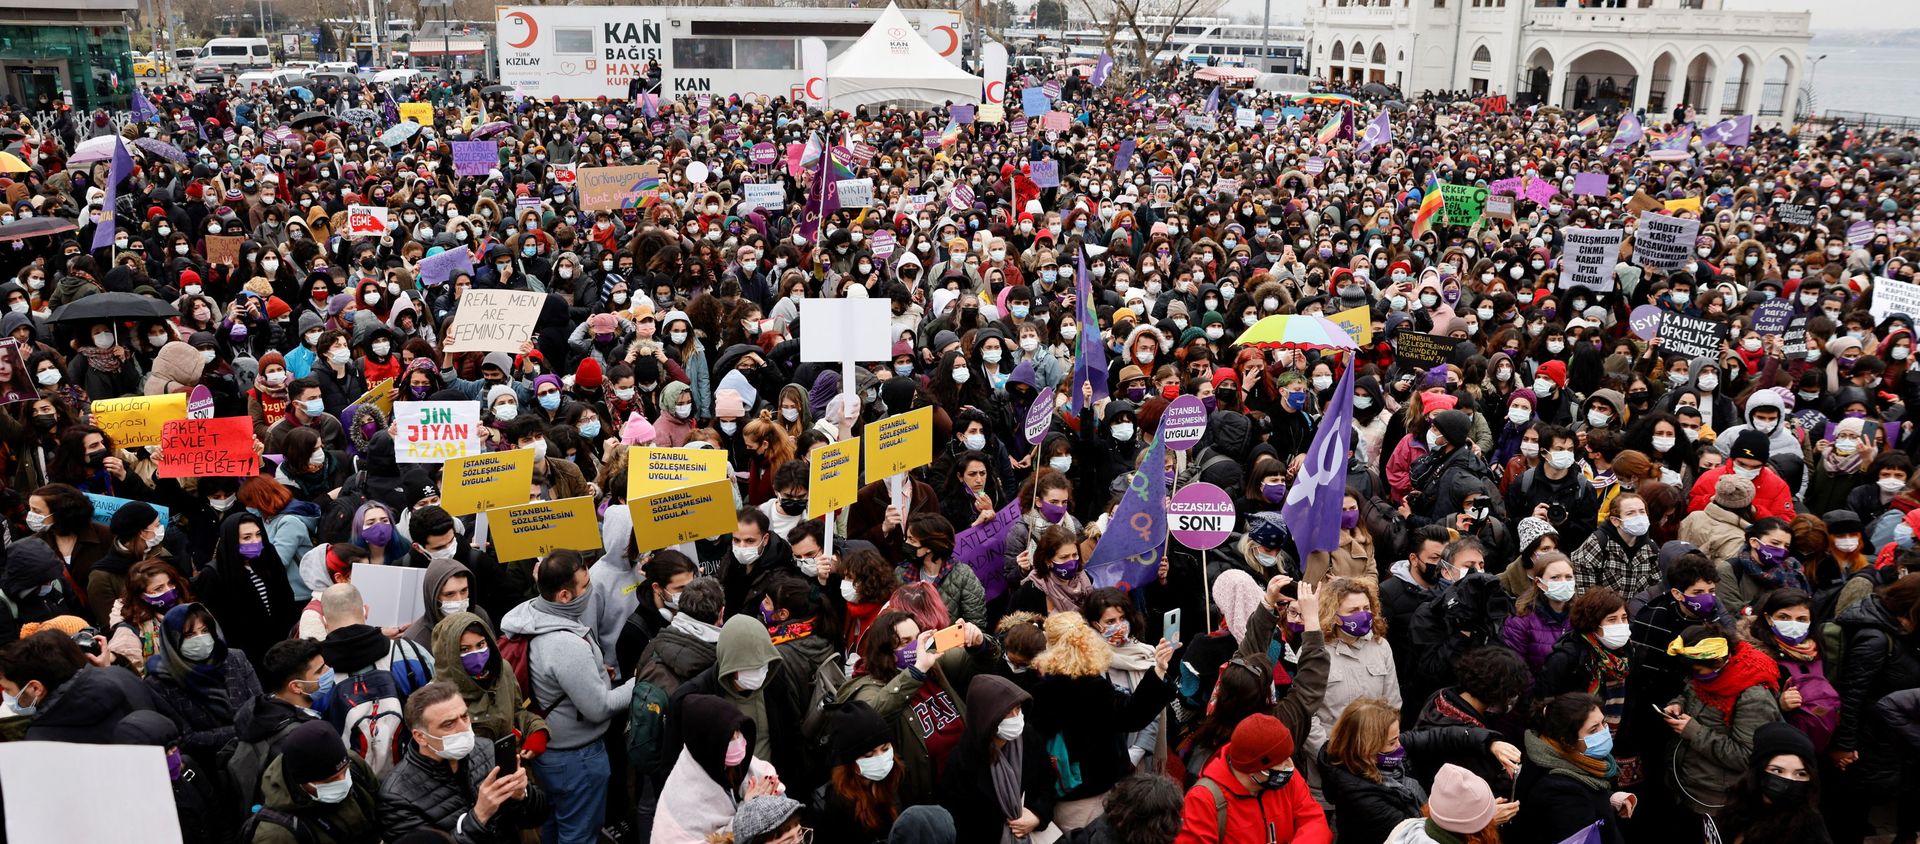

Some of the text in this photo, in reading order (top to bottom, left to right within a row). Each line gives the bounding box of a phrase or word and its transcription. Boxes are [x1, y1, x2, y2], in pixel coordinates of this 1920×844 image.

[604, 23, 661, 44] KAN
[506, 58, 540, 66] KIZILAY
[606, 63, 662, 75] HAYA
[674, 77, 710, 91] KAN
[1441, 185, 1467, 195] ERKEK
[1437, 215, 1472, 224] AALET
[1648, 220, 1684, 234] ŞİDDETE
[1567, 233, 1620, 246] SÖZLEŞMEDEN
[1649, 231, 1676, 244] KARŞI
[1579, 245, 1604, 255] ÇIKMA
[1577, 263, 1598, 275] İPTAL
[1571, 273, 1603, 285] EDİLSİN!
[464, 291, 540, 307] REAL MEN
[480, 308, 508, 321] ARE
[1630, 312, 1662, 331] İSYA
[1663, 313, 1717, 333] KADINIZ
[454, 323, 531, 343] FEMINISTS
[1660, 323, 1720, 348] ÖFKELİYİZ
[1168, 405, 1202, 417] İSTANBUL
[97, 415, 146, 430] Sonrası
[879, 418, 907, 432] İSTANBUL
[1164, 415, 1206, 426] ÖZLEŞMESİNİ
[163, 420, 207, 435] ERKEK
[1164, 428, 1199, 440] UYGULA!
[161, 433, 222, 450] DEVLET
[649, 450, 689, 461] İSTANBUL
[193, 456, 254, 476] ELBET!
[463, 457, 500, 468] İSTANBUL
[648, 461, 707, 473] SÖZLEŞMESİNİ
[462, 462, 516, 477] SÖZLEŞMESİNİ
[461, 475, 494, 487] UYGULA!
[648, 472, 683, 481] UYGULA!
[650, 491, 692, 506] İSTANBUL
[652, 494, 713, 514] SÖZLEŞMESİNİ
[509, 506, 553, 518] İSTANBUL
[1170, 501, 1234, 513] CEZASIZLIĞA
[511, 509, 574, 526] SÖZLEŞMESİNİ
[653, 509, 689, 522] UYGULA!
[513, 523, 550, 534] UYGULA!
[1179, 515, 1221, 531] SON!
